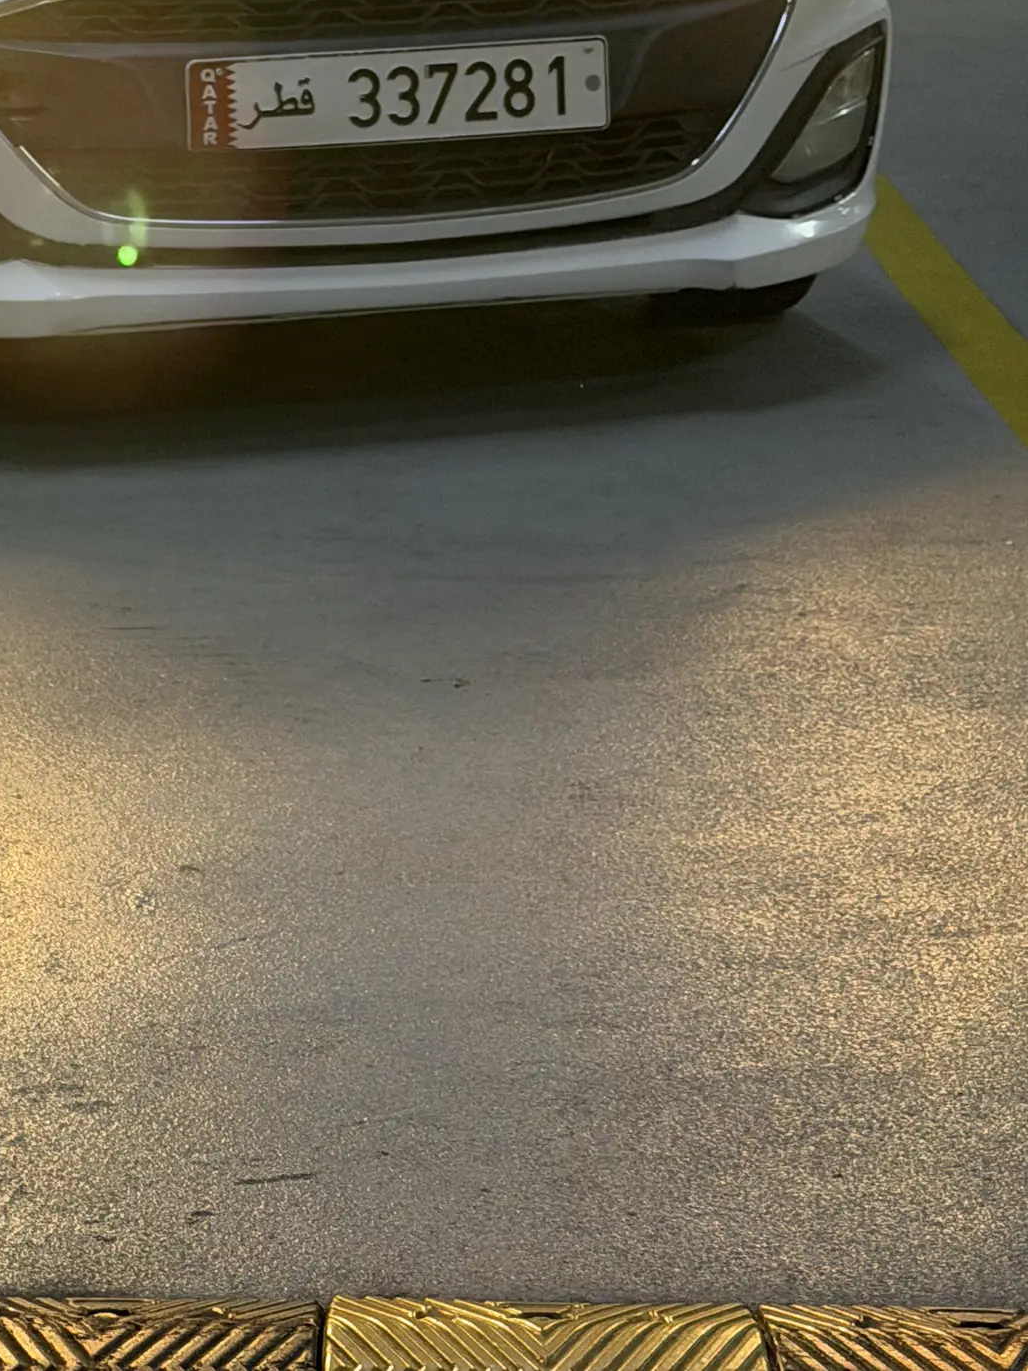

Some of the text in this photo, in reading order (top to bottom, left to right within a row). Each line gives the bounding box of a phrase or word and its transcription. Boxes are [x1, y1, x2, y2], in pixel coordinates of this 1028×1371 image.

[200, 69, 219, 146] QATAR
[237, 56, 566, 130] قطر 337281
